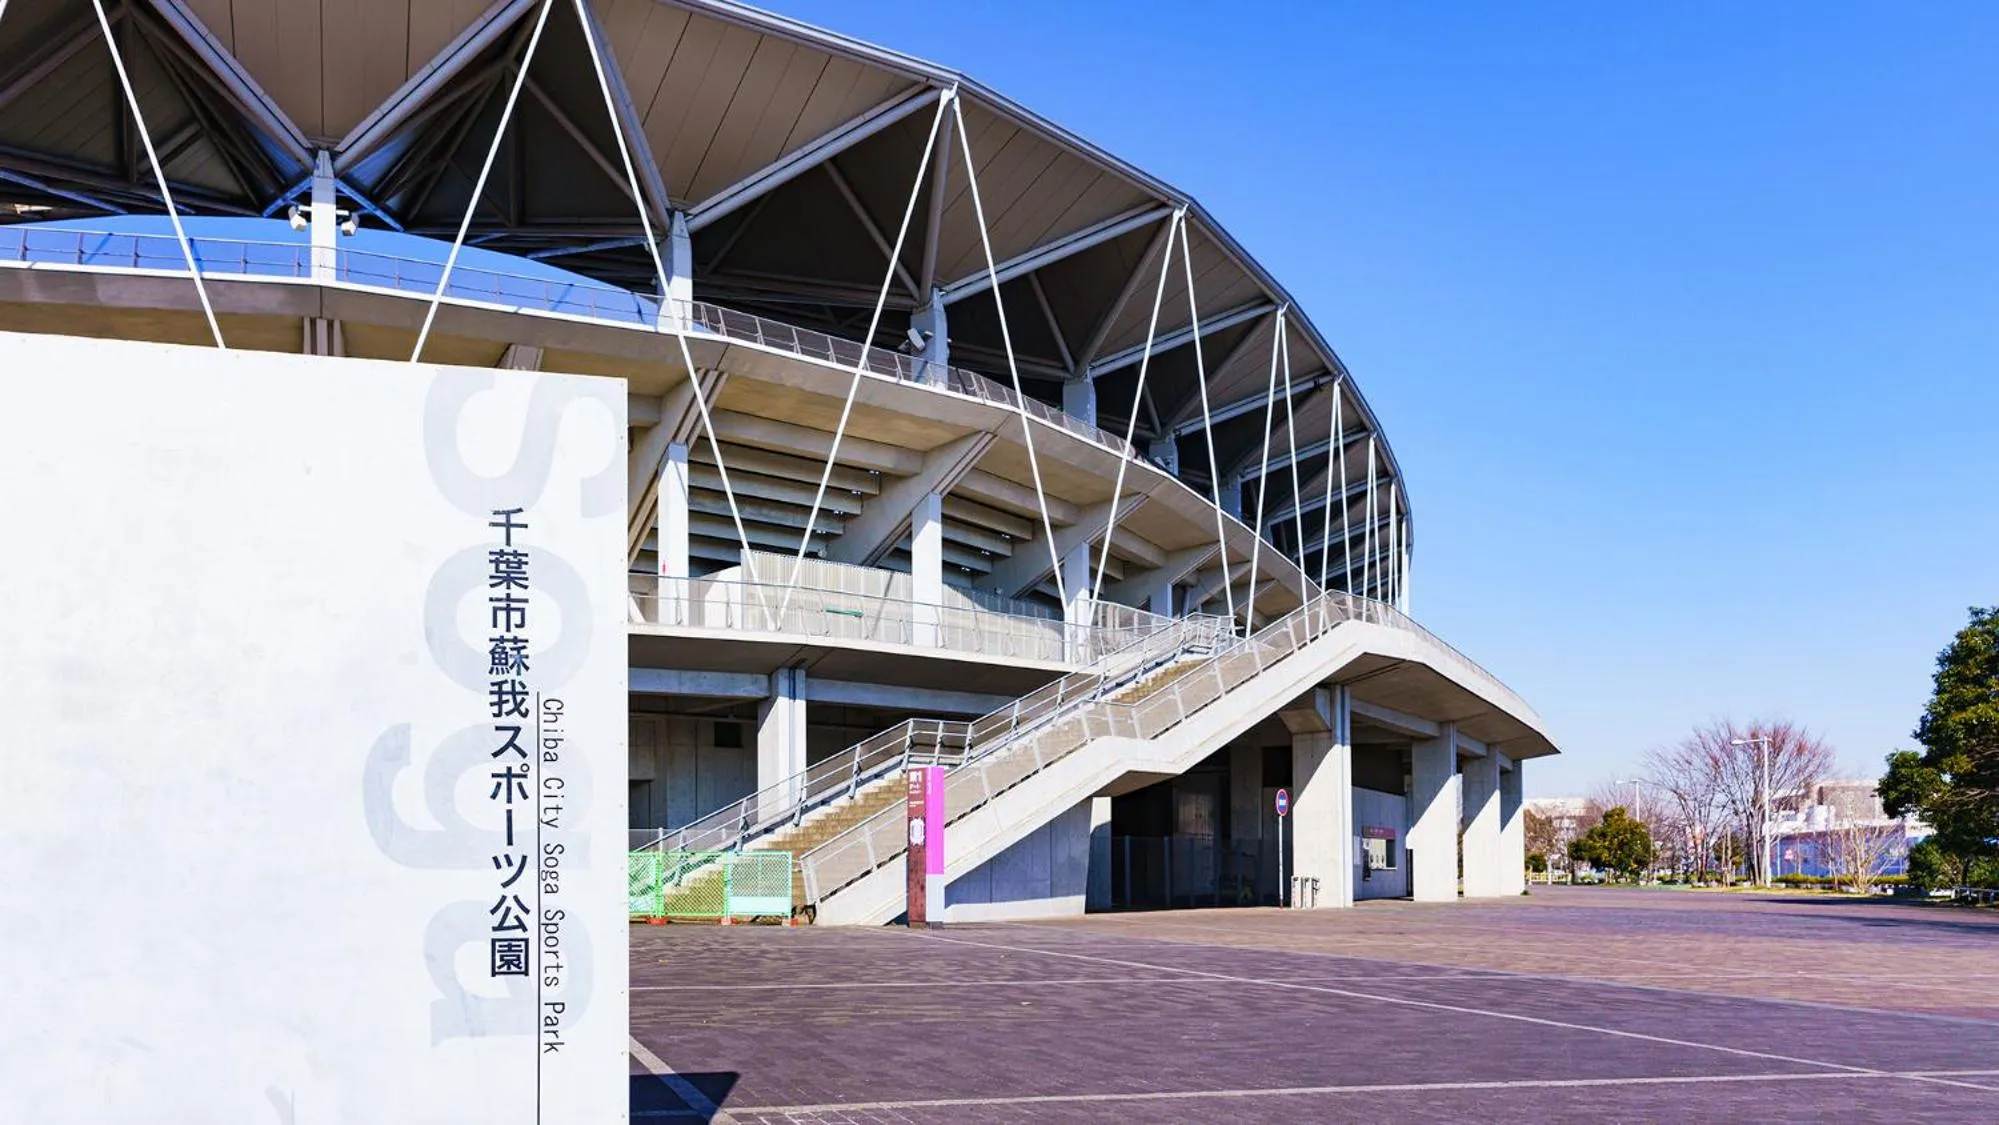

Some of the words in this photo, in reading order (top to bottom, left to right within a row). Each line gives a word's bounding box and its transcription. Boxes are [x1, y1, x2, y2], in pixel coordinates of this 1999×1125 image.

[489, 508, 530, 977] 千葉市蘇我スポーツ公園
[543, 698, 564, 763] Chiba
[542, 777, 565, 828] City
[542, 843, 565, 894] Soga
[542, 909, 565, 987] Sports
[543, 1001, 565, 1053] Park
